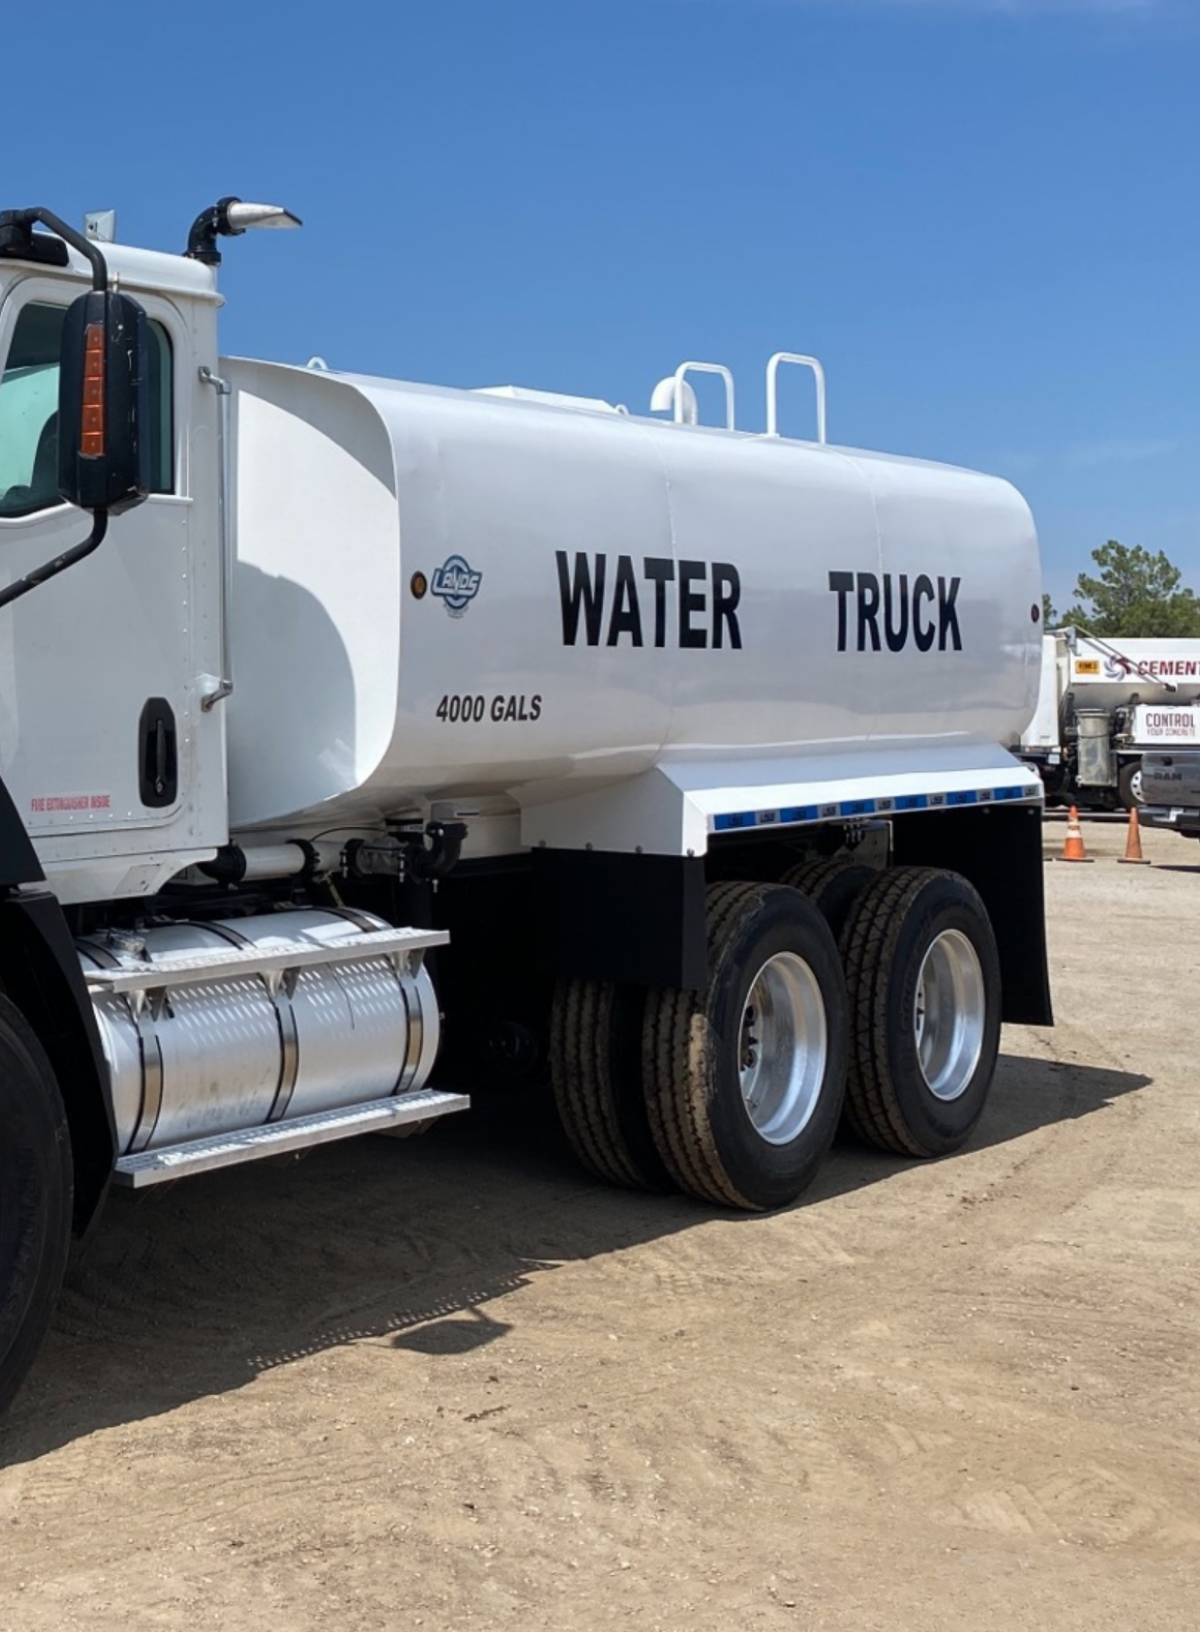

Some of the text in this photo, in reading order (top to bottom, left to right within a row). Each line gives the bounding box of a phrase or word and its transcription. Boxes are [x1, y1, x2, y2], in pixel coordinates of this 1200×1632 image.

[555, 550, 963, 652] WATER TRUCK
[436, 694, 542, 722] 4000 GALS
[1145, 713, 1194, 727] CONTROL
